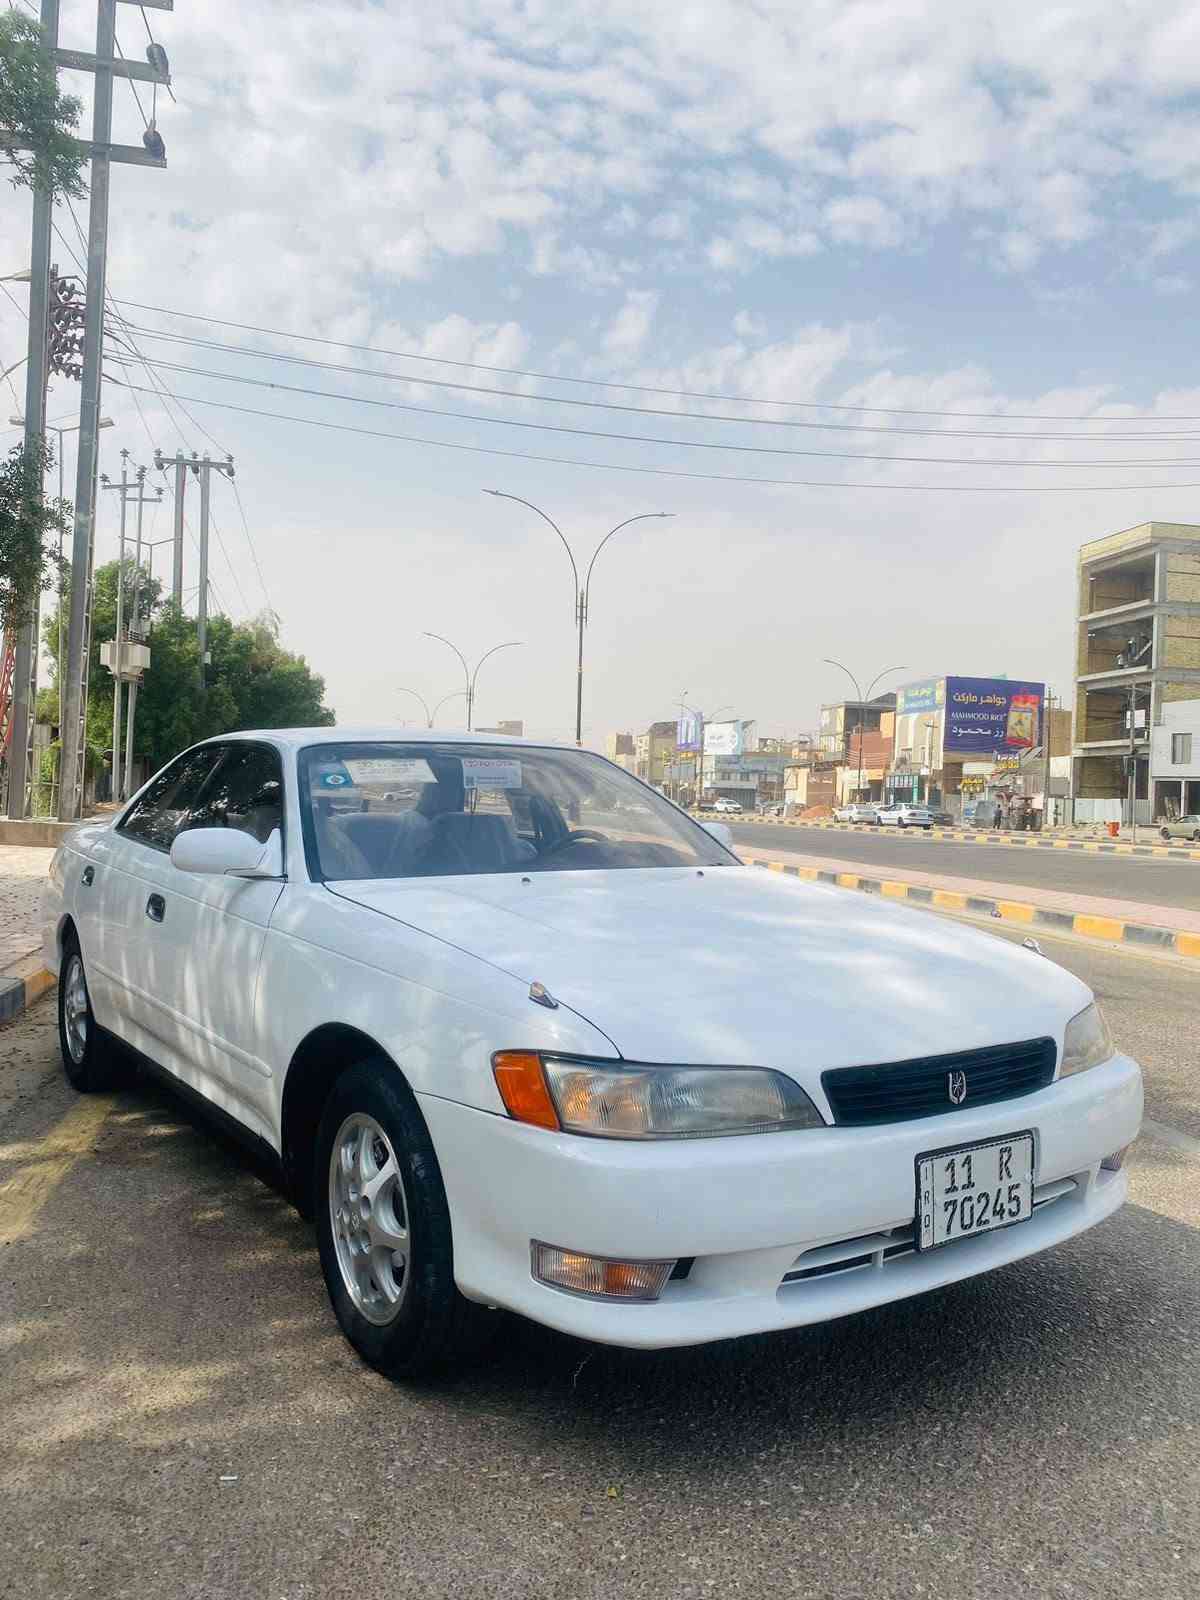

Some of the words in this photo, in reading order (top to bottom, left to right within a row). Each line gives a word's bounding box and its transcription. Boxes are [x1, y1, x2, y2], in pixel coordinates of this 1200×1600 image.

[951, 711, 989, 721] MAHMOOD
[952, 725, 992, 737] محمود
[993, 727, 1004, 738] رز
[945, 1155, 975, 1194] 11
[999, 1146, 1012, 1181] R
[943, 1183, 1021, 1235] 70245
